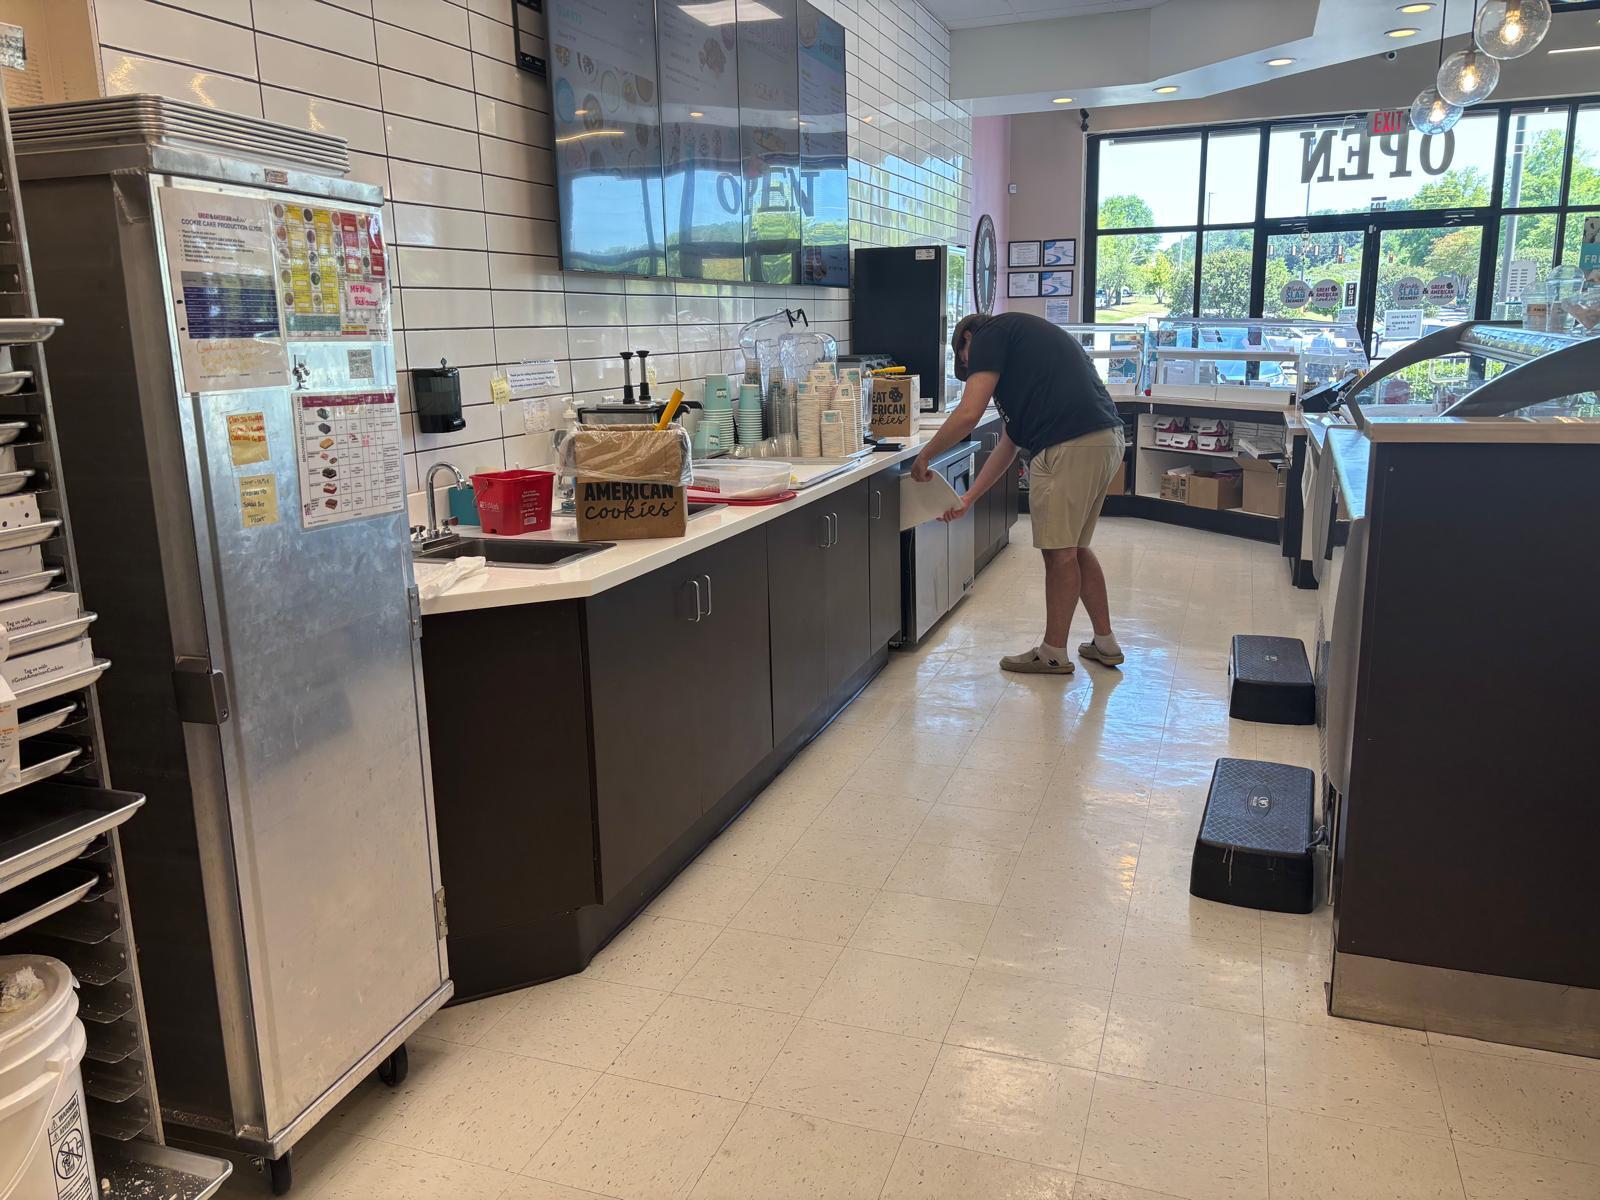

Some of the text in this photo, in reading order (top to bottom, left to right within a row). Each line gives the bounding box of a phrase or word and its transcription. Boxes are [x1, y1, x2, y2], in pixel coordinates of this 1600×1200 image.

[1373, 111, 1404, 134] EXIT
[217, 222, 248, 231] PRODUCTION
[872, 392, 887, 402] EAT
[872, 404, 906, 414] ERICAN
[871, 414, 907, 426] okies
[584, 482, 674, 501] AMERICAN
[585, 496, 677, 520] cookies
[7, 619, 47, 632] tAmericanCookies
[58, 1097, 76, 1122] WARNING
